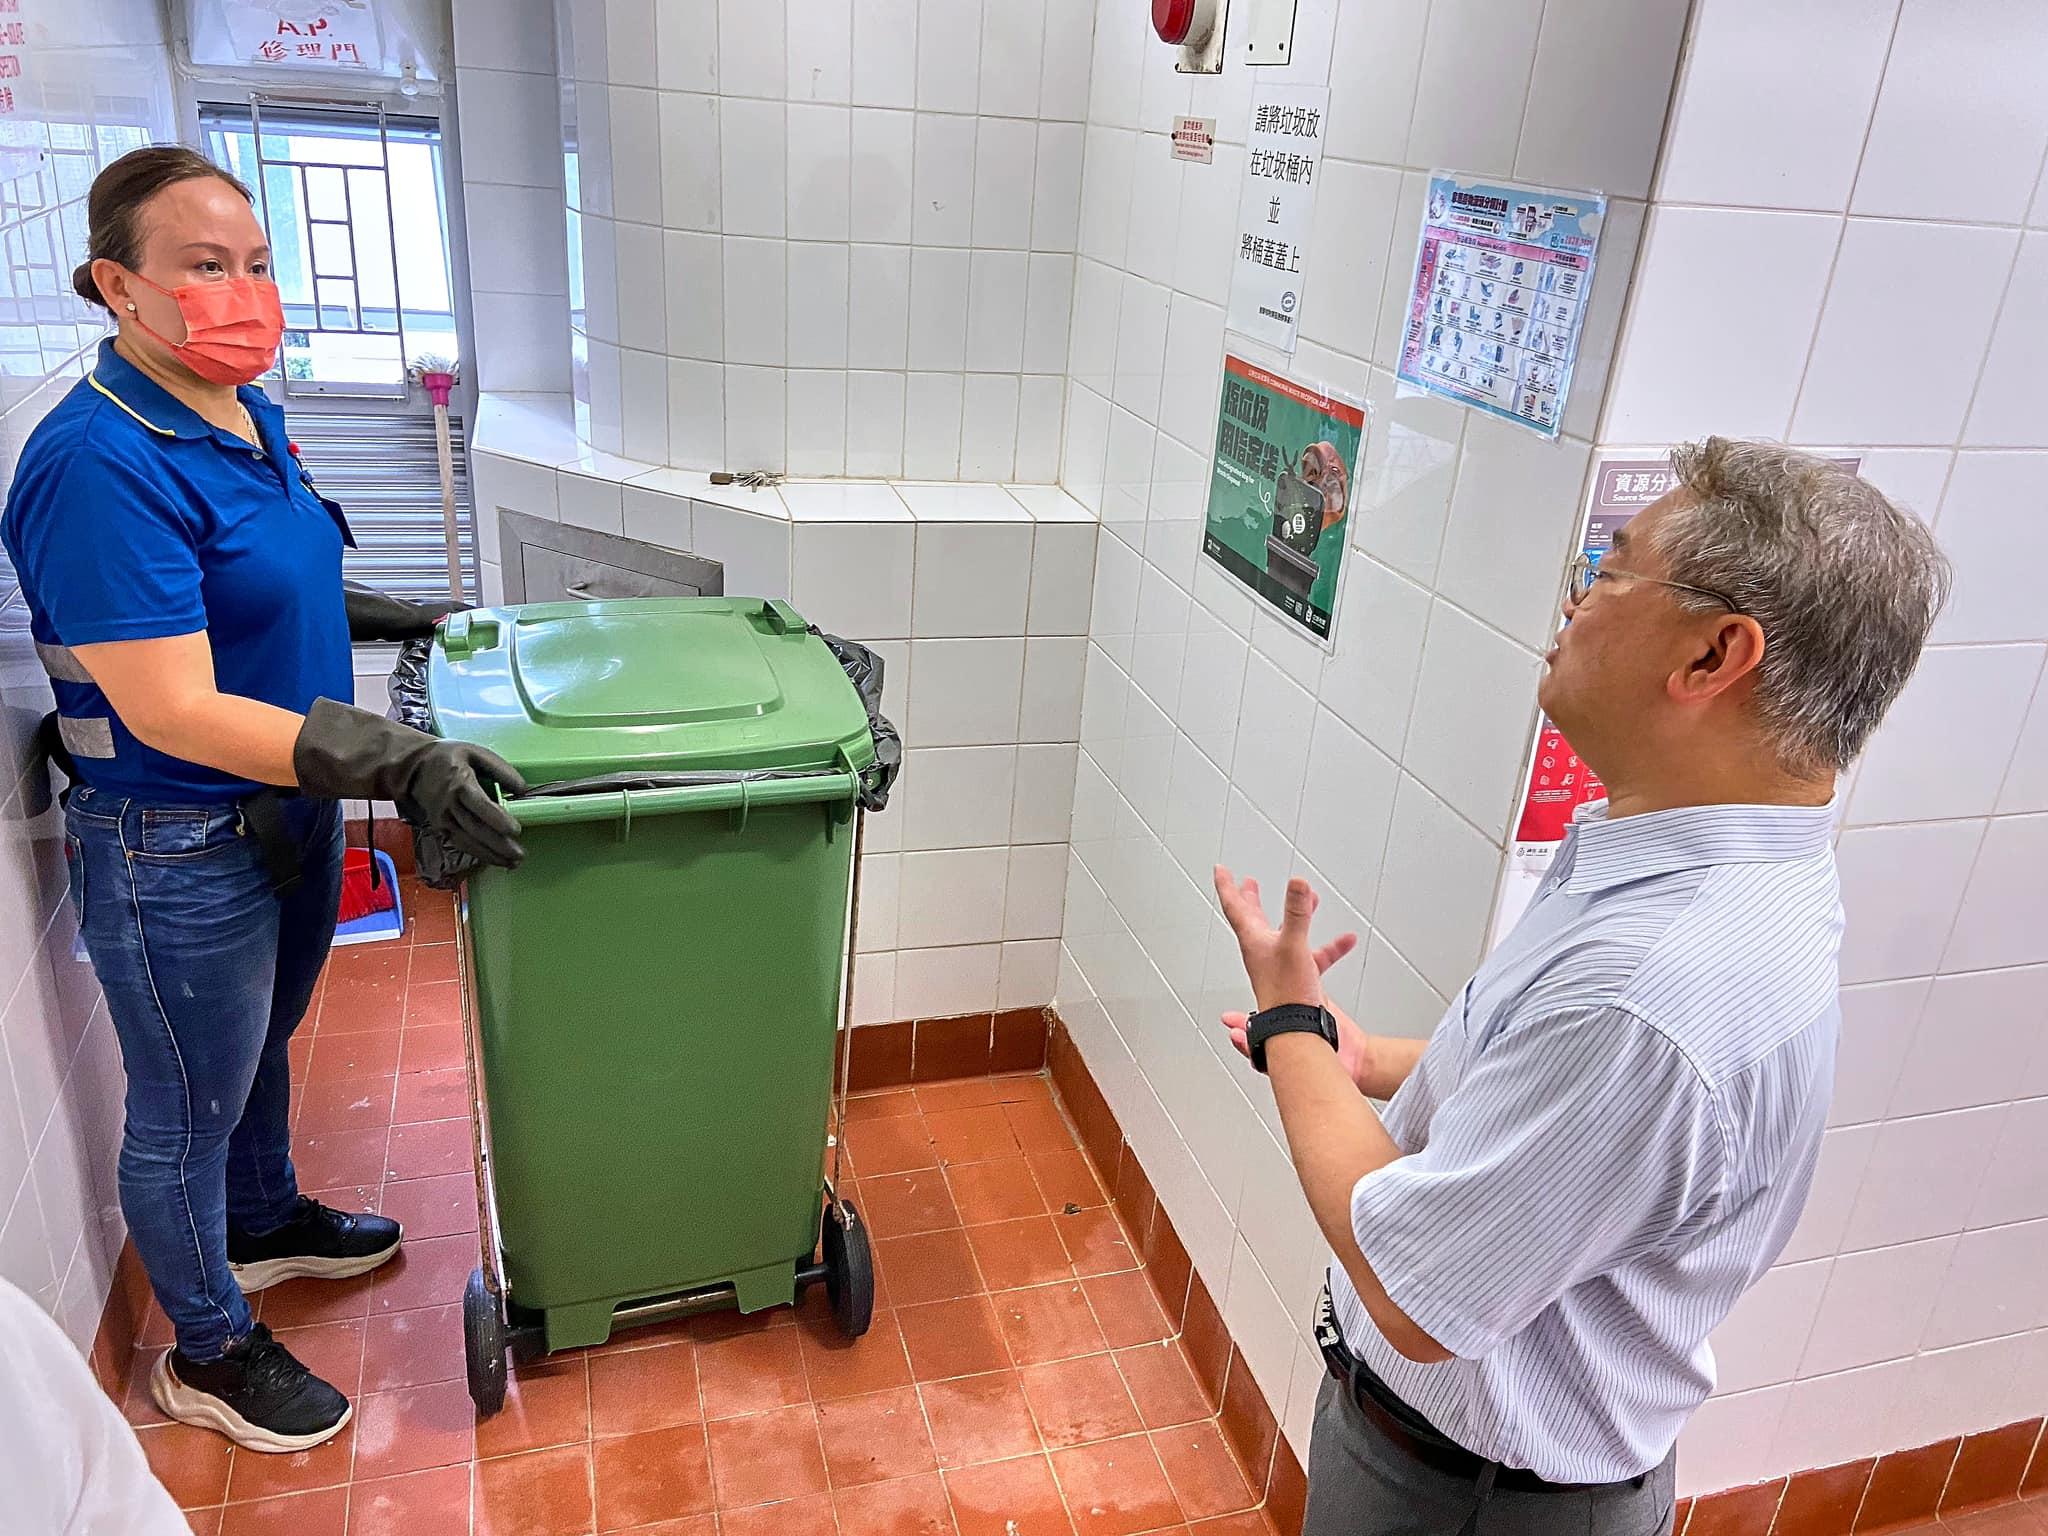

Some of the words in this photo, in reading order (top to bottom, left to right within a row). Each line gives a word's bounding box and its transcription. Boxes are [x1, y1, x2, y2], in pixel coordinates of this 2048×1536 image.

[277, 18, 334, 37] A.P.
[259, 40, 361, 64] 修理門
[1255, 104, 1320, 138] 請將垃圾放
[1250, 148, 1313, 185] 在垃圾桶內
[1267, 196, 1281, 224] 並
[1240, 232, 1300, 273] 將桶蓋蓋上
[1612, 494, 1638, 502] Source
